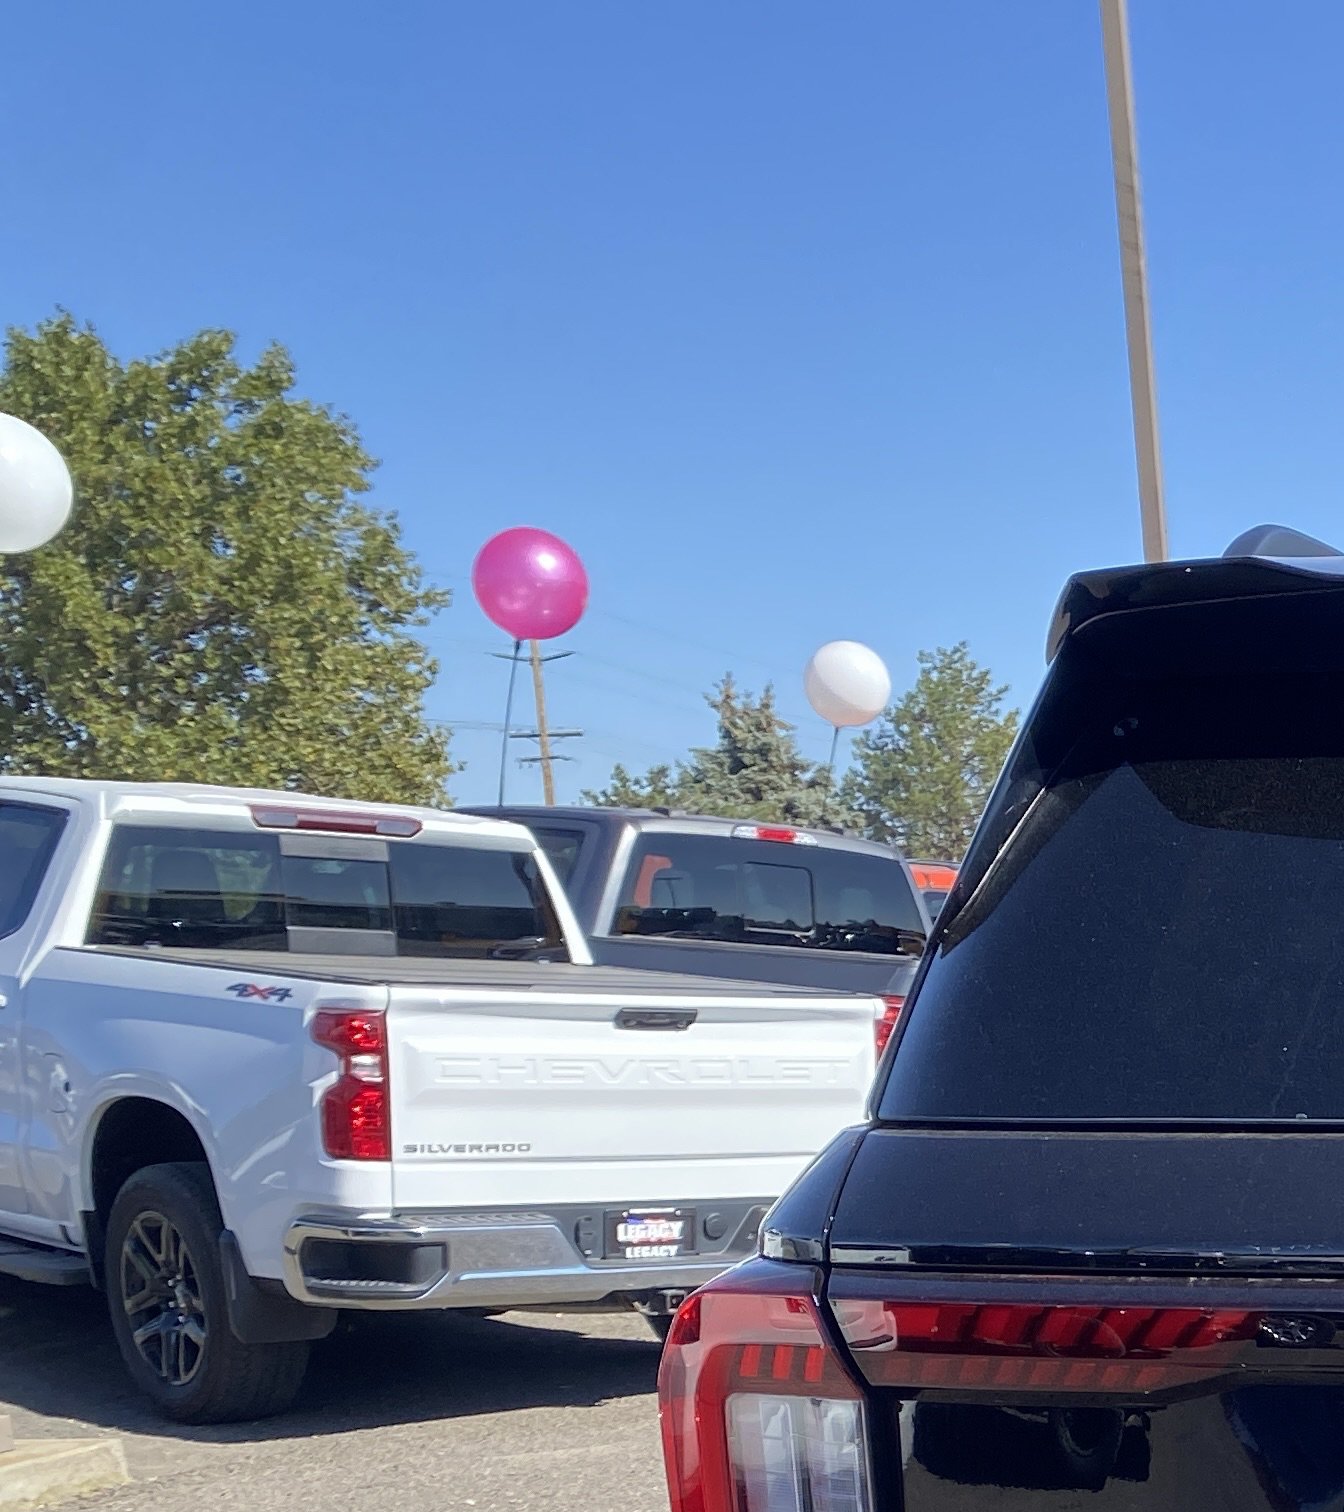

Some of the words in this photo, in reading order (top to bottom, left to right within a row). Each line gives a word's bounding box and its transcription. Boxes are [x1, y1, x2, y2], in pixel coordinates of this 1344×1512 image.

[433, 1056, 851, 1085] CHEVROLET
[402, 1142, 531, 1154] SILVERADO
[617, 1221, 684, 1242] LEGACY
[625, 1245, 678, 1259] LEGACY
